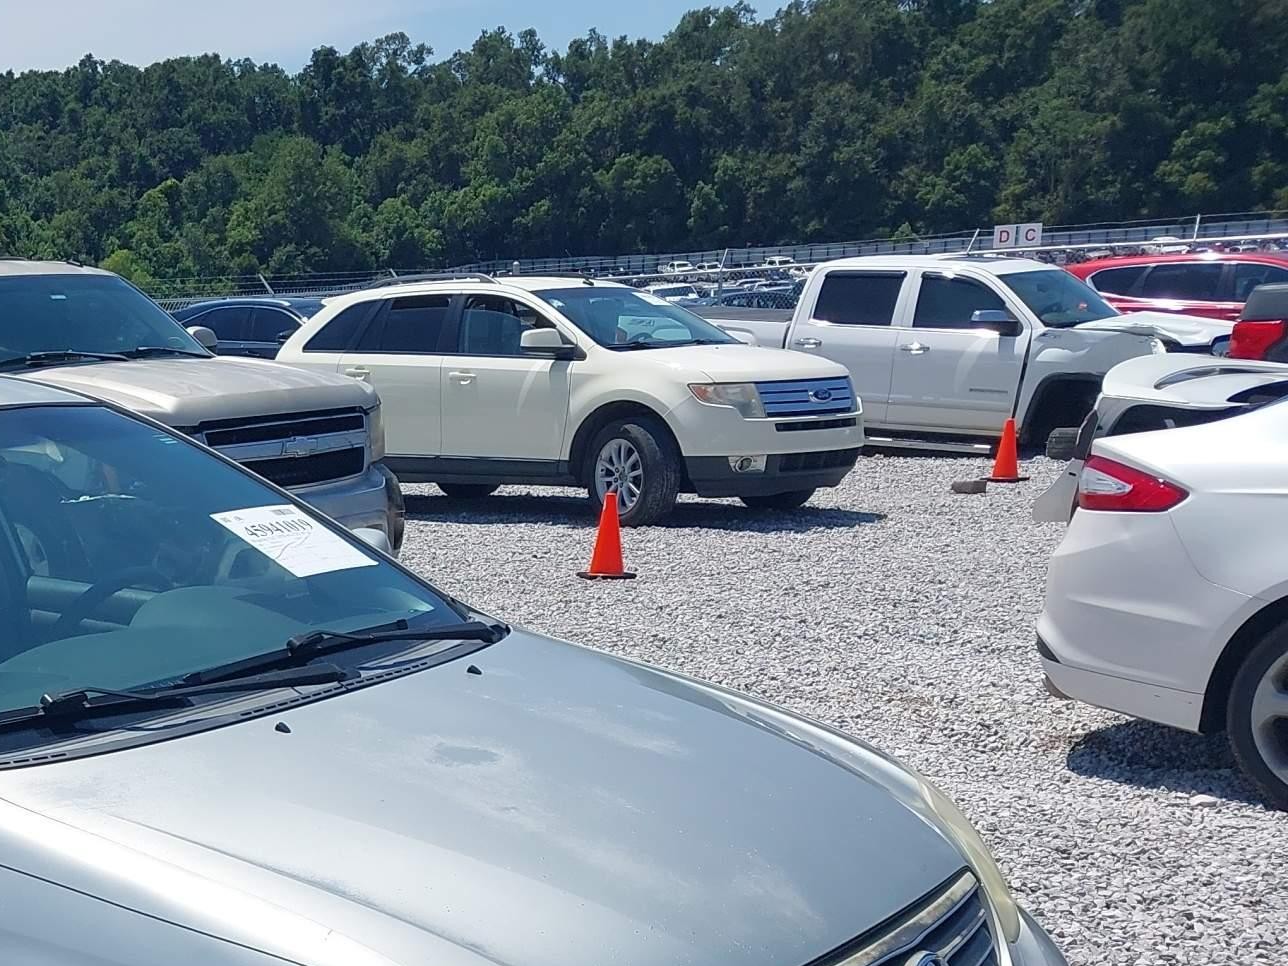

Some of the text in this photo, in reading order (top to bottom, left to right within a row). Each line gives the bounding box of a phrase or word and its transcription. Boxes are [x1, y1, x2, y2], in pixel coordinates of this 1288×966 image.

[999, 230, 1010, 243] D
[1025, 228, 1036, 241] C
[244, 518, 314, 538] 45941019
